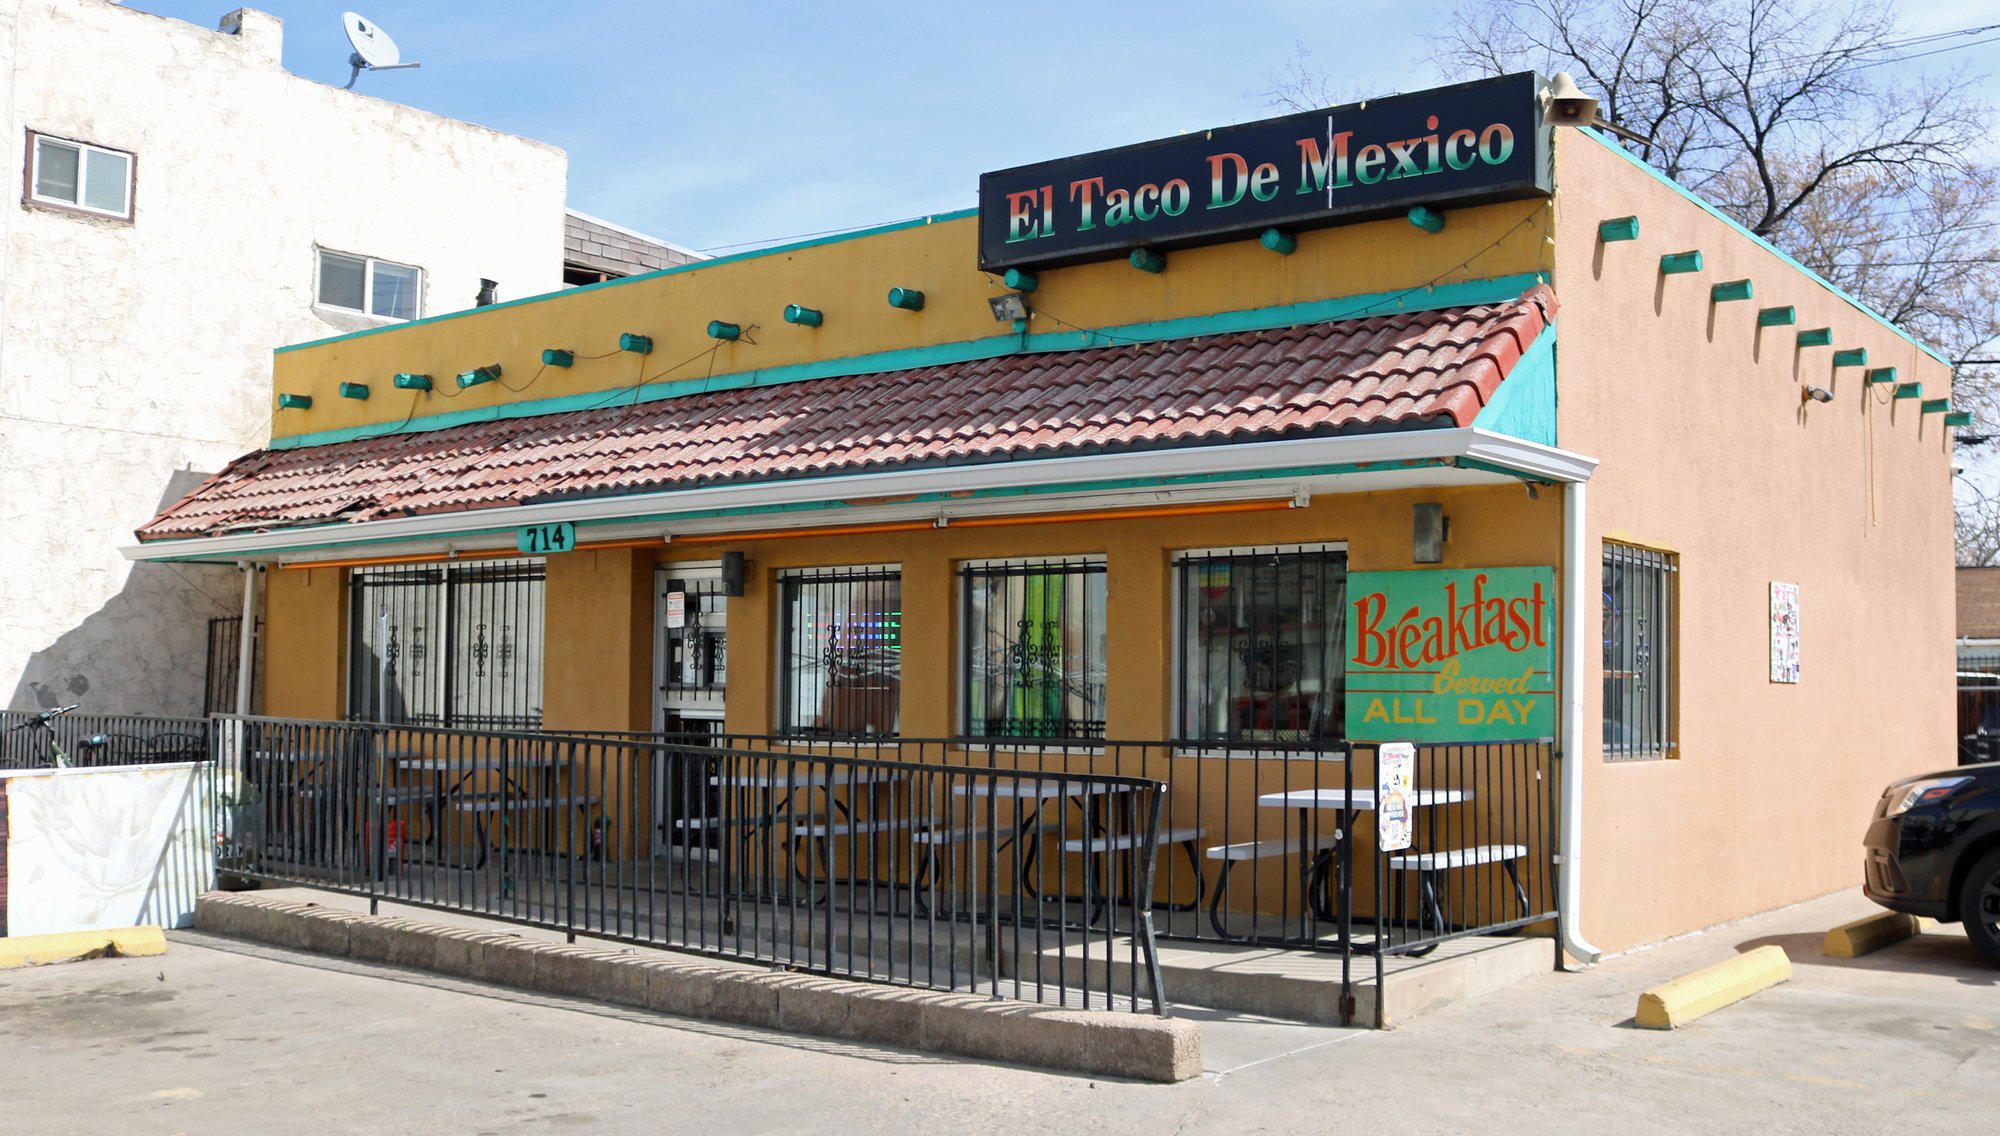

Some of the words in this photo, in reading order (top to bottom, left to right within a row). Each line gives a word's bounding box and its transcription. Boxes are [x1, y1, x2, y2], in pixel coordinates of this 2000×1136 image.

[1005, 185, 1055, 244] El
[1070, 176, 1191, 234] Taco
[1206, 152, 1280, 210] De
[1296, 115, 1515, 196] Mexico
[527, 524, 565, 552] 714
[1352, 573, 1547, 669] Breakfast
[1433, 658, 1535, 694] Served
[1362, 698, 1438, 725] ALL
[1457, 700, 1537, 726] DAY
